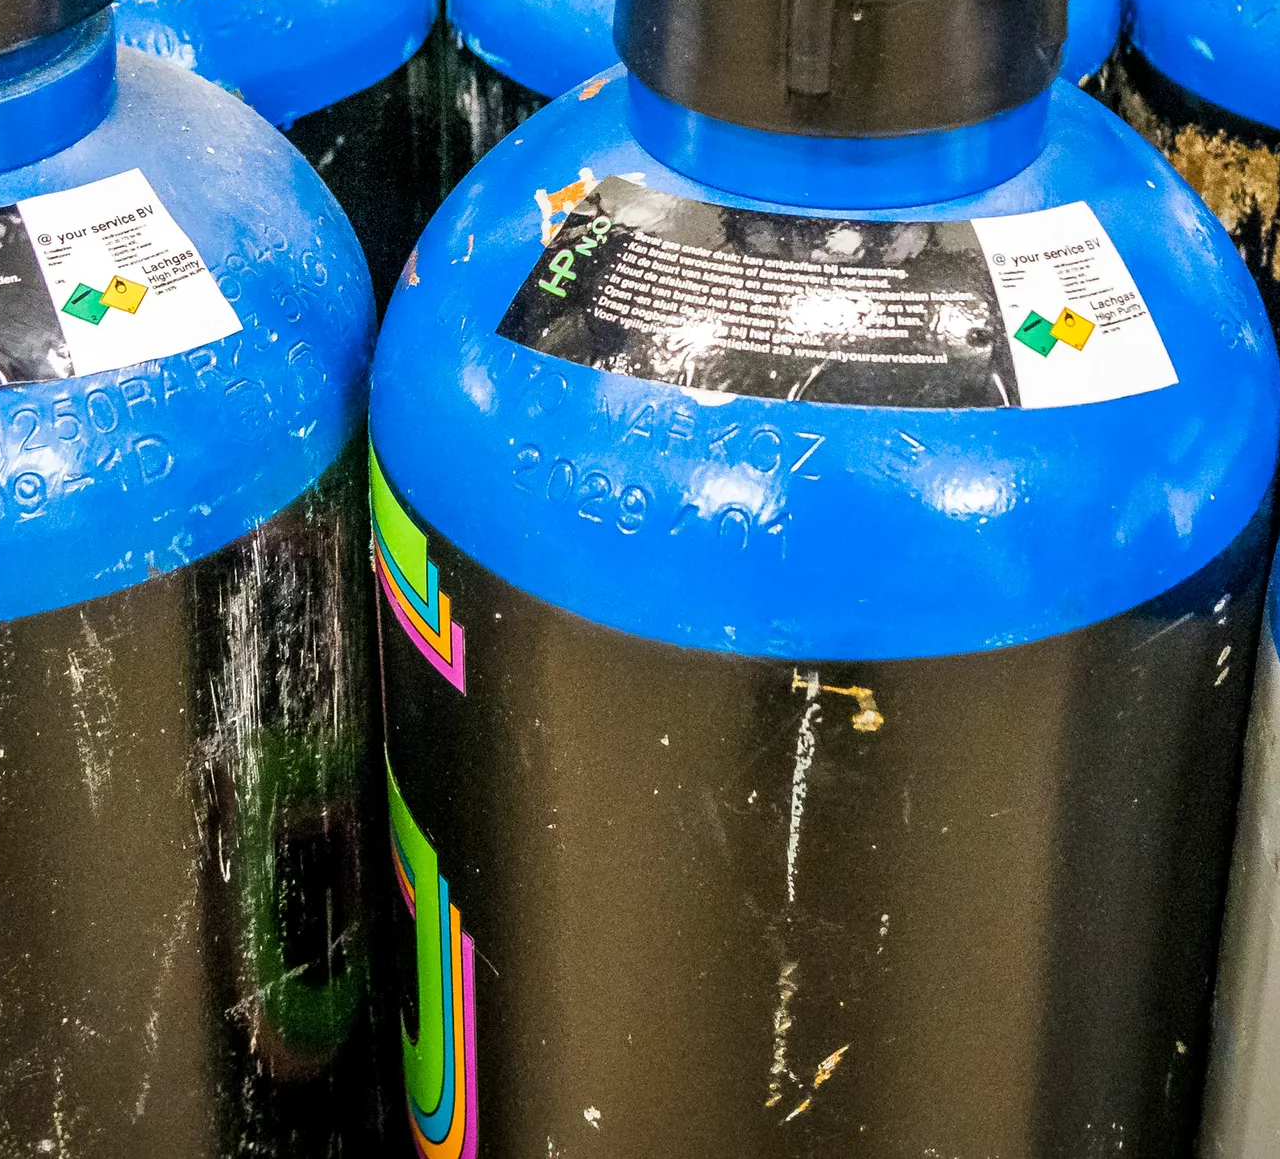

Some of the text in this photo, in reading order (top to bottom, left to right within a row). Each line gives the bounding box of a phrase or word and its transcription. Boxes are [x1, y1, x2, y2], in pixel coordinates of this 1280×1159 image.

[37, 205, 154, 246] @ your service BV
[141, 249, 194, 275] Lachgas
[634, 231, 909, 280] Bevat gas onder kan ontploffen verwarming.
[992, 238, 1101, 267] @ your service BV
[147, 268, 171, 285] High
[173, 259, 200, 275] Purity
[538, 249, 577, 298] HP
[616, 262, 658, 281] Houd de
[637, 257, 744, 290] de buurt van kleding
[649, 247, 891, 289] brand veroorzaken oxiderend.
[597, 295, 630, 314] Draag
[604, 286, 633, 302] Open
[672, 289, 706, 304] brand
[1089, 291, 1136, 311] Lachgas
[593, 307, 619, 322] Voor
[1095, 311, 1116, 322] High
